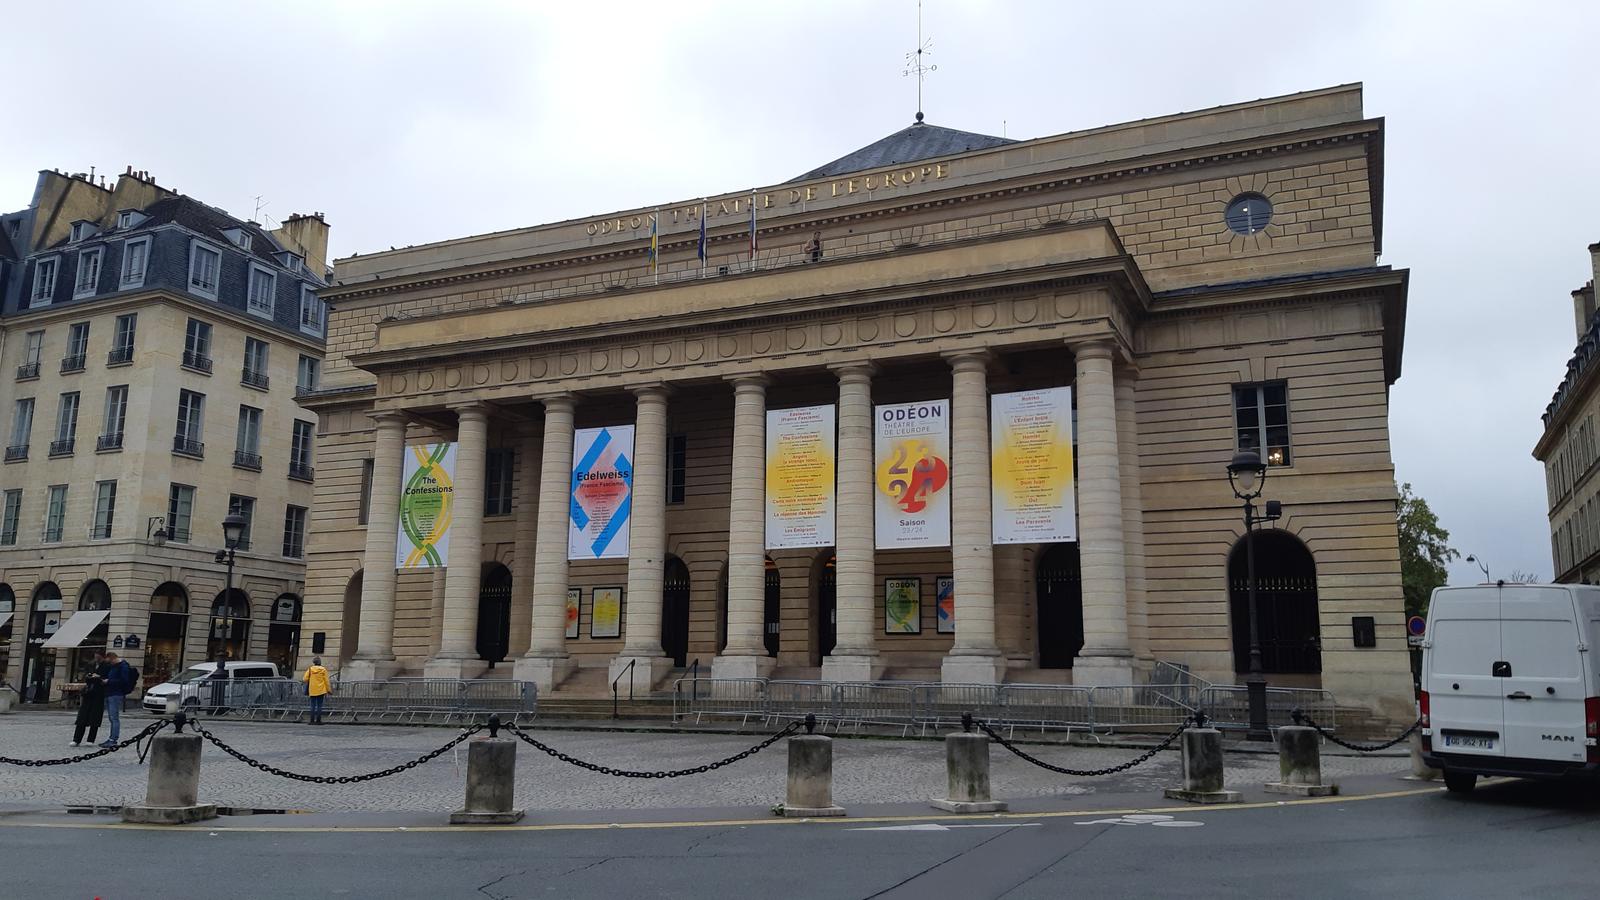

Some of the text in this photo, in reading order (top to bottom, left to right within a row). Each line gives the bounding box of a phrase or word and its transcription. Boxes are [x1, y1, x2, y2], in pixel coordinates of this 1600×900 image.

[789, 187, 817, 205] DE
[831, 162, 949, 198] L'EUROPE
[883, 404, 941, 421] ODÉON
[576, 470, 629, 481] Edelweiss
[405, 486, 453, 495] Confessions
[899, 519, 926, 527] Saison
[1541, 734, 1575, 743] MAN
